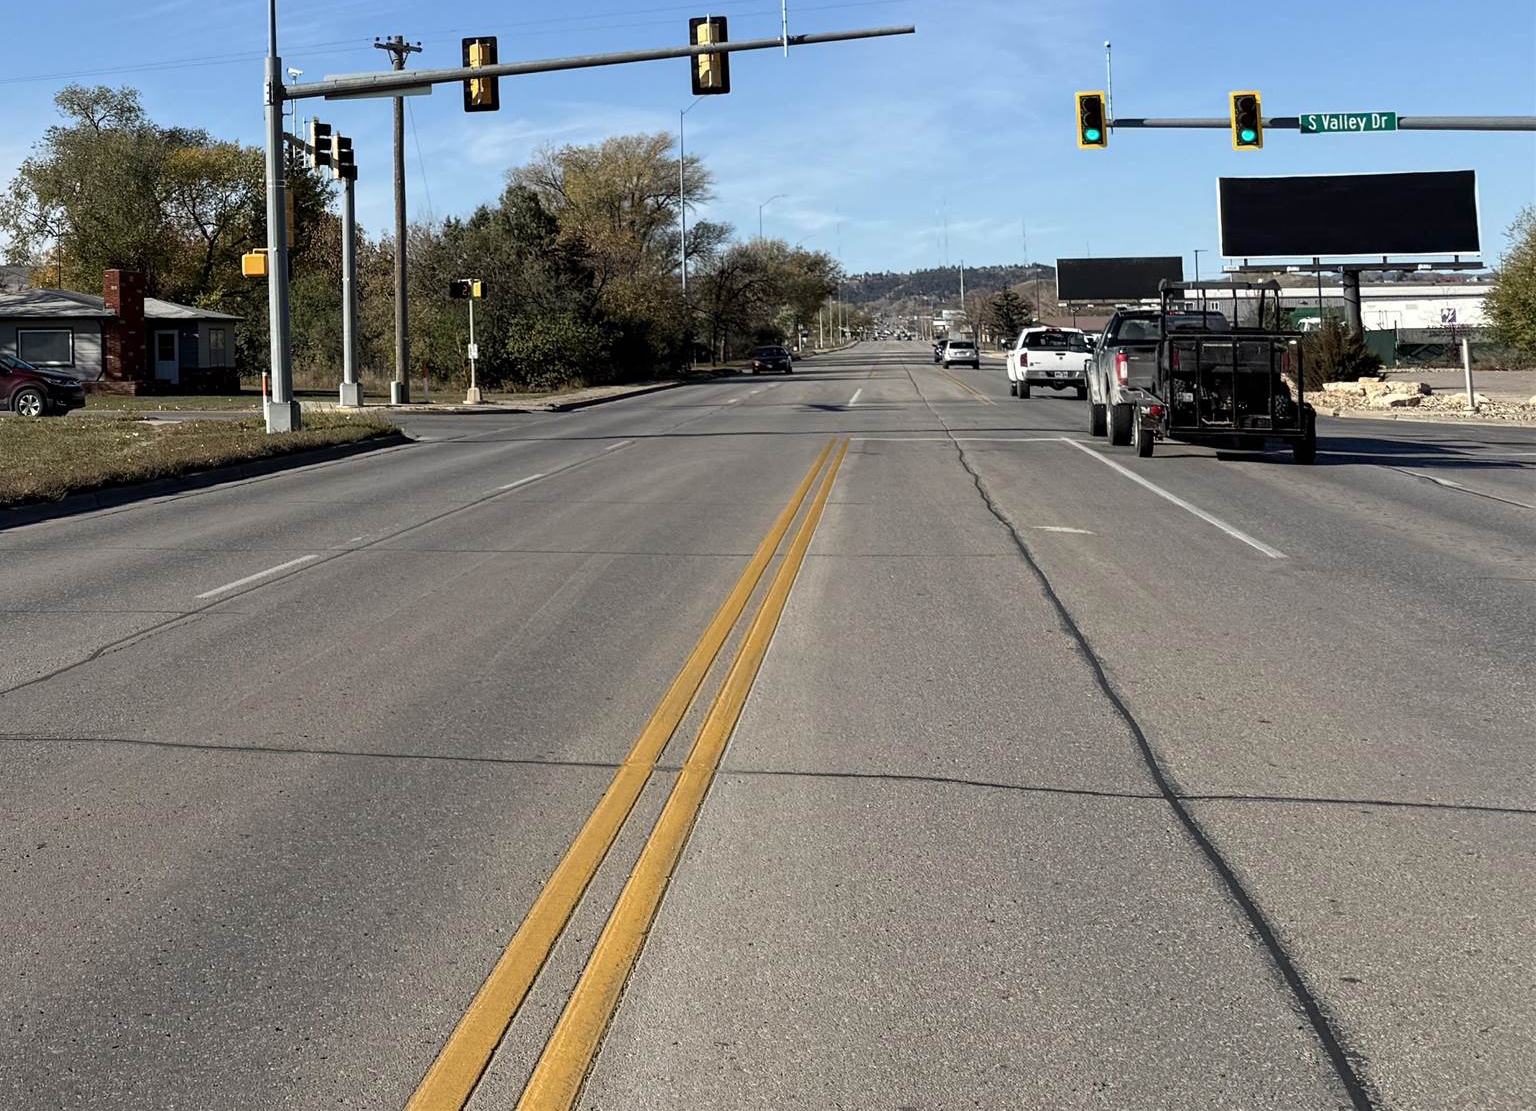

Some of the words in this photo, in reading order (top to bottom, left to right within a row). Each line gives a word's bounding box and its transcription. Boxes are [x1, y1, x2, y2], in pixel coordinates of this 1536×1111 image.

[1308, 115, 1317, 130] S
[1321, 114, 1366, 131] Valley
[1371, 113, 1388, 129] Dr
